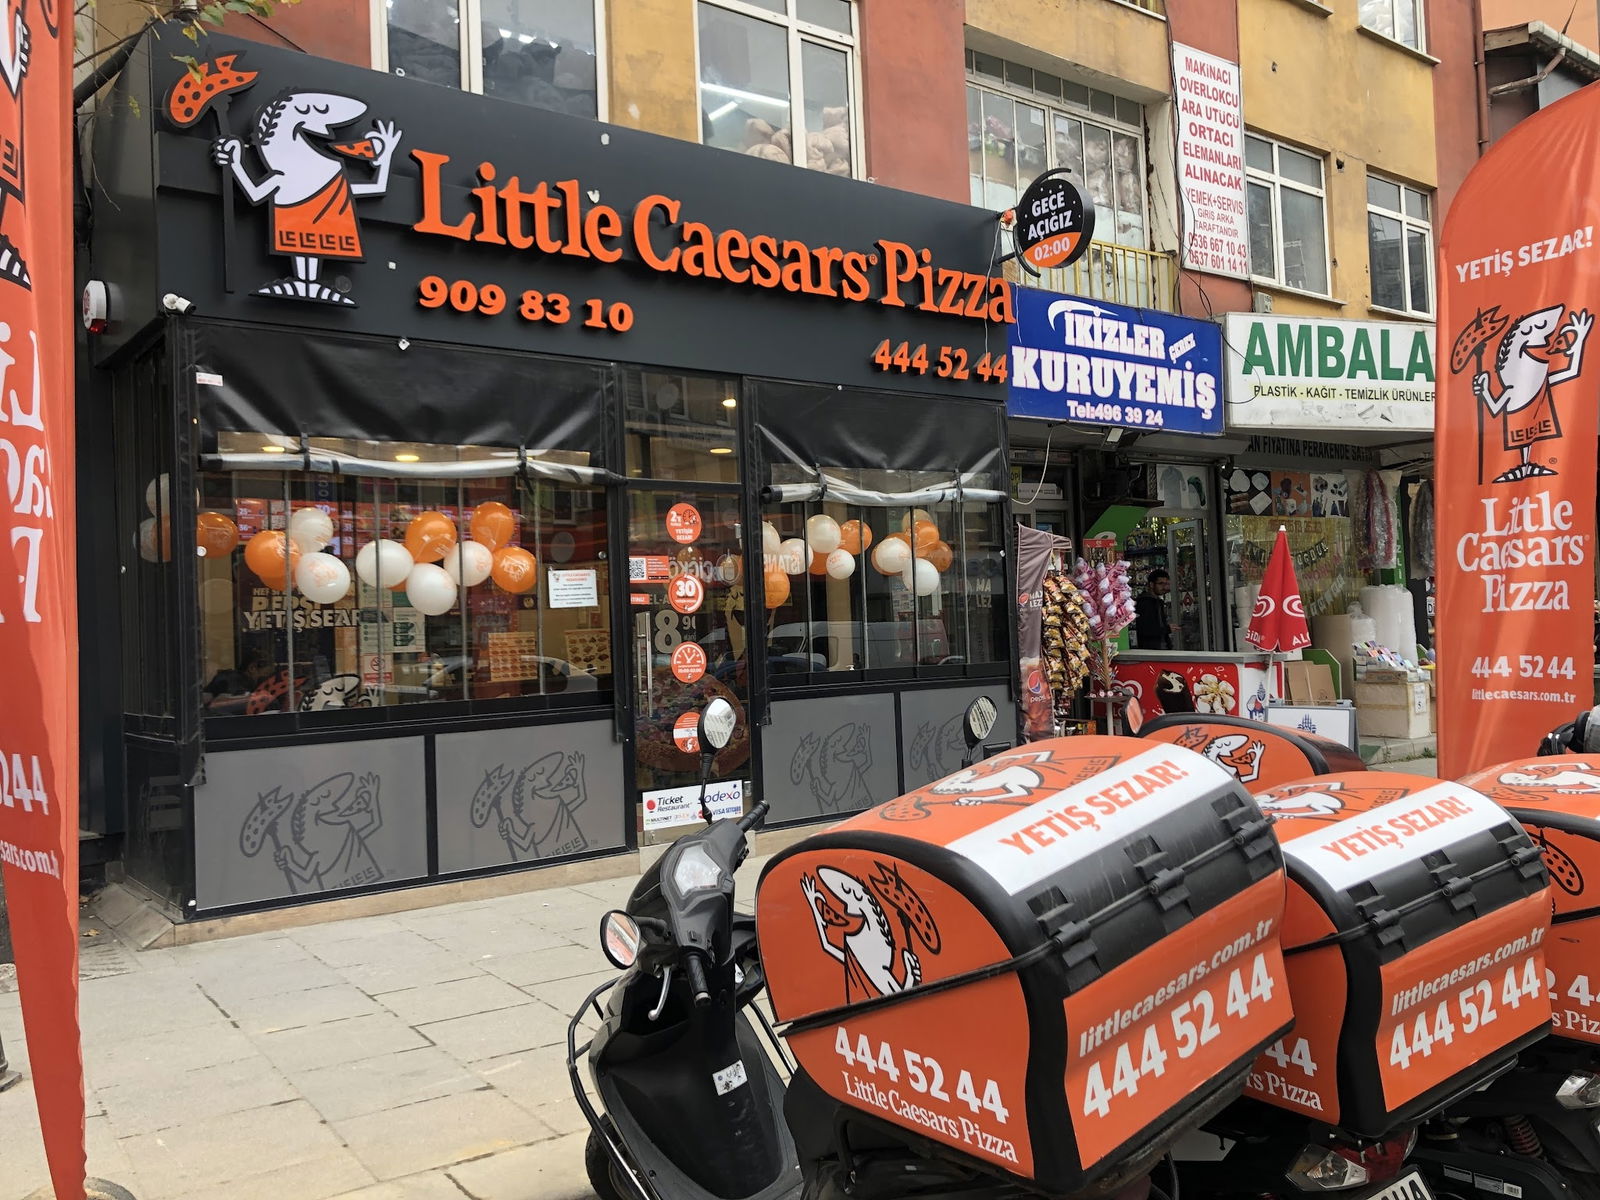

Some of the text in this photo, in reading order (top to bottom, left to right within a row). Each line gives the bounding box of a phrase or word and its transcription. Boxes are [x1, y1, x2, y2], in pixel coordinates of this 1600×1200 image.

[1182, 98, 1203, 118] ARA
[1189, 122, 1233, 147] ORTACI
[1183, 141, 1241, 170] ELEMANLARI
[1185, 163, 1242, 191] ALINACAK
[1031, 191, 1065, 217] GECE
[1216, 213, 1235, 225] ARKA
[412, 149, 623, 263] Little
[878, 239, 1016, 324] Pizza
[1028, 210, 1073, 240] AÇIĞIZ
[1034, 237, 1070, 260] 02:00
[1209, 239, 1224, 253] 667
[1226, 241, 1235, 255] 10
[1237, 244, 1247, 258] 43
[1211, 254, 1225, 270] 601
[1228, 258, 1237, 272] 14
[1239, 260, 1248, 275] 11
[1456, 226, 1593, 283] YETİŞ SEZAR!
[419, 275, 634, 332] 909 83 10
[1064, 302, 1166, 360] İKİZLER
[873, 338, 1008, 383] 444 52 44
[1242, 322, 1435, 382] AMBALA
[1011, 345, 1216, 420] KURUYEMİŞ
[1253, 384, 1297, 397] PLASTİK
[1306, 385, 1337, 398] KAĞIT
[1345, 387, 1389, 401] TEMİZLİK
[1124, 406, 1143, 424] 39
[1145, 409, 1163, 426] 24
[676, 580, 696, 597] 30
[1481, 574, 1570, 613] Pizza
[244, 610, 306, 632] YETŞ
[1471, 655, 1576, 680] 444 52 44
[657, 796, 684, 806] Ticket
[697, 790, 741, 805] odexo
[998, 760, 1189, 855] YETİŞ SEZAR!
[1320, 796, 1474, 862] YETİŞ SEZAR!
[1080, 918, 1273, 1058] littlecaesars.com.tr
[1391, 926, 1545, 1017] littlecaesars.com.tr
[1389, 957, 1541, 1070] 444 52 44
[1083, 953, 1275, 1118] 444 52 44
[835, 1026, 1010, 1124] 444 52 44
[1264, 1071, 1323, 1112] Pizza
[841, 1071, 1019, 1164] Little Caesars Pizza
